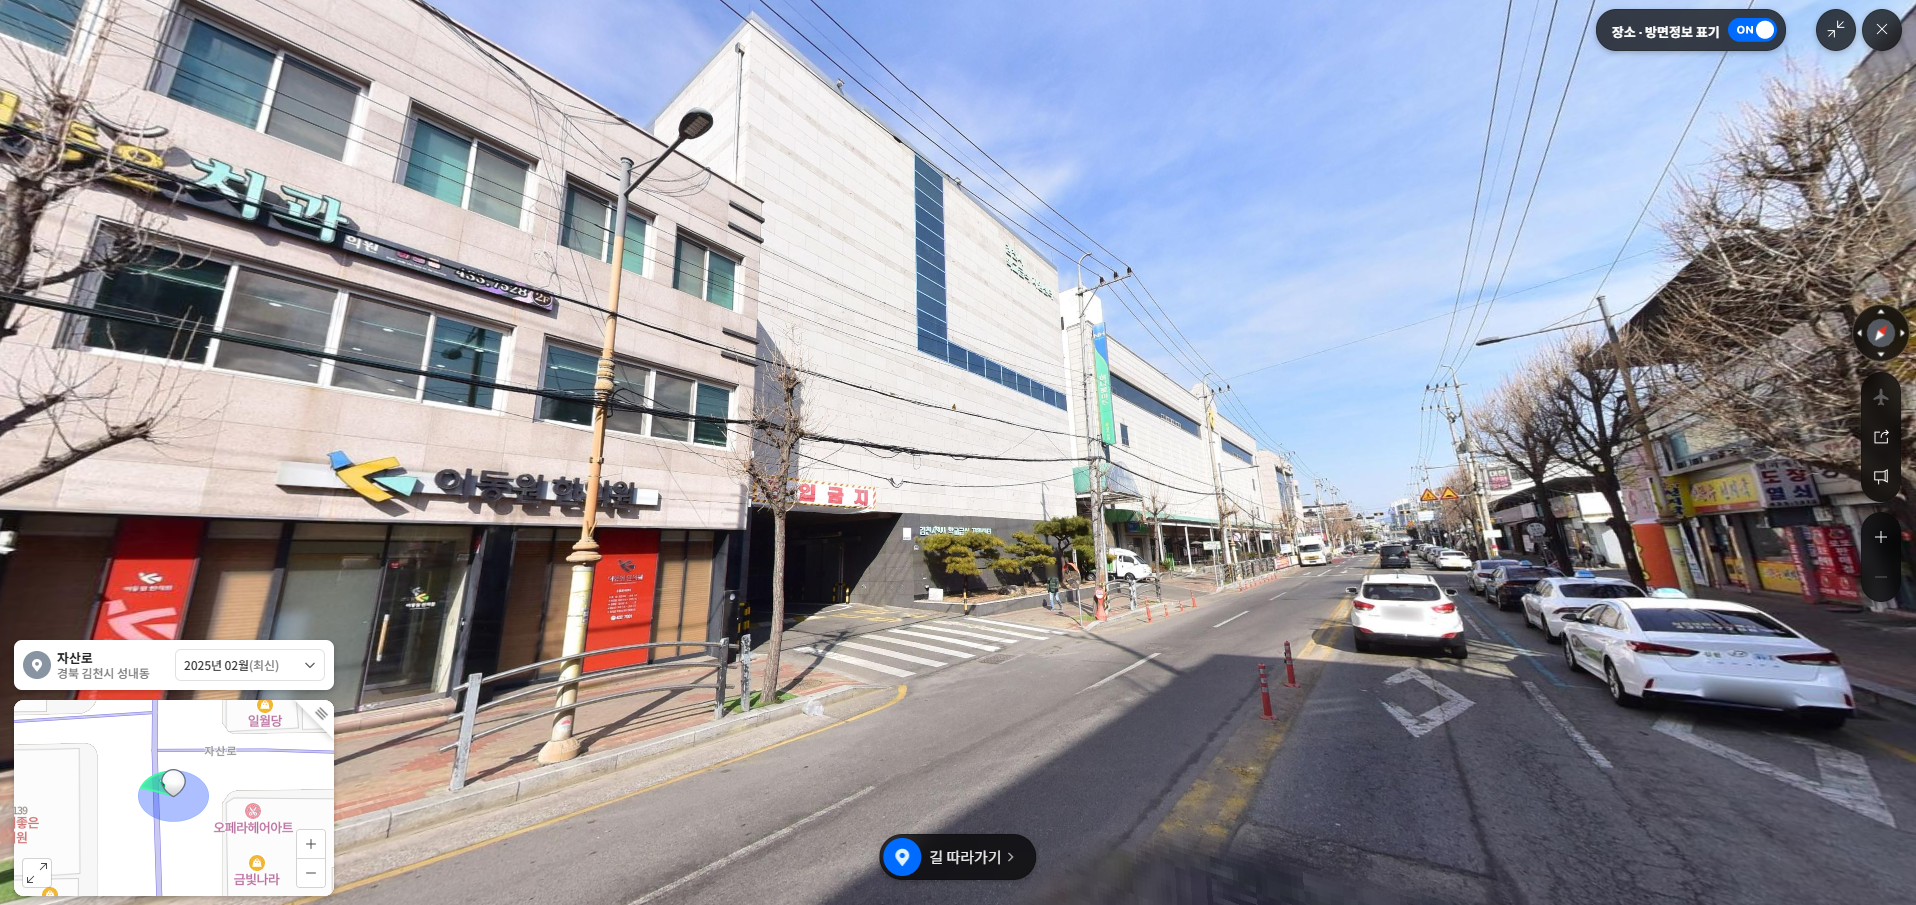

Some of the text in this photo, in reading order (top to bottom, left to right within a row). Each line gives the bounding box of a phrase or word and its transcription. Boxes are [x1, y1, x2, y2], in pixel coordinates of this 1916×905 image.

[191, 157, 350, 244] 치과
[434, 467, 546, 505] 이동원
[1761, 467, 1808, 484] 도장
[1766, 484, 1814, 501] 열쇠
